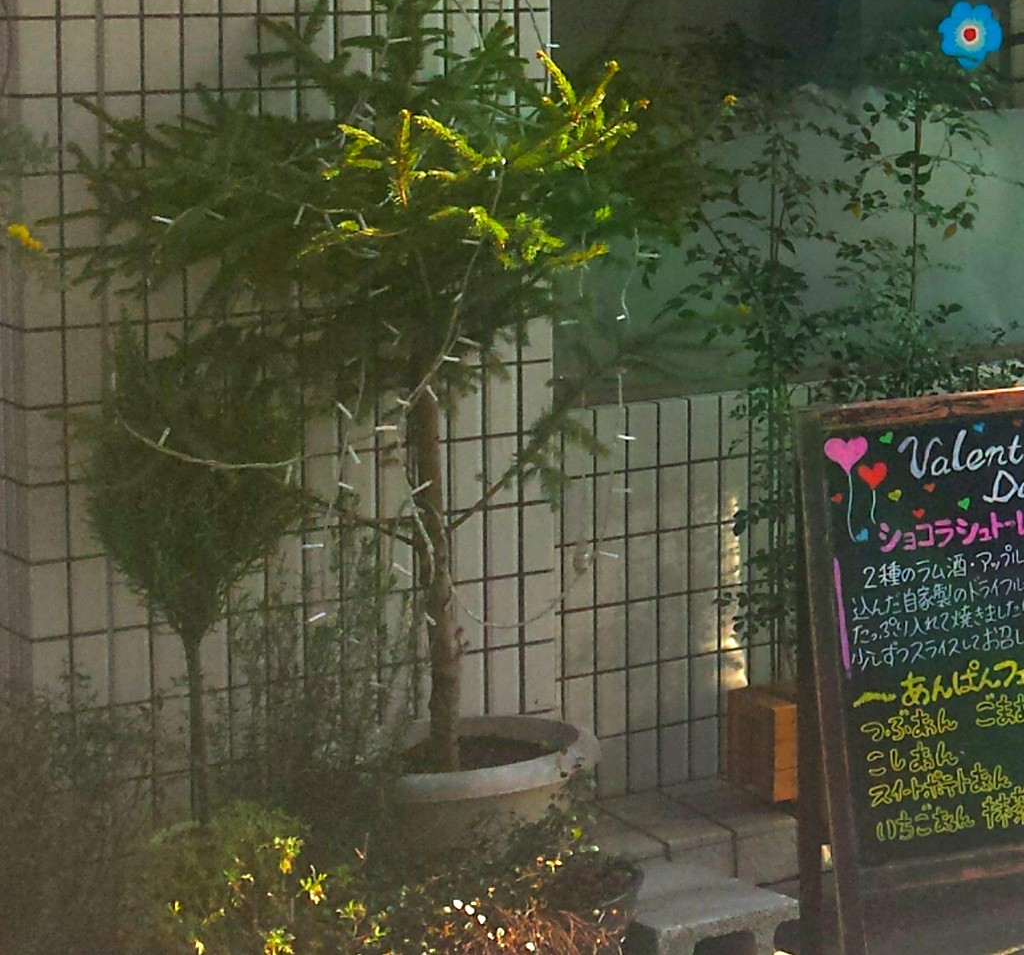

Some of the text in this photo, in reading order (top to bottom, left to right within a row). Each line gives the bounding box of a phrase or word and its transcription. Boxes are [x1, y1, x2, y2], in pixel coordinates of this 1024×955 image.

[860, 708, 958, 742] つぶあん
[866, 741, 959, 777] こしあん
[875, 803, 975, 842] いちごあん
